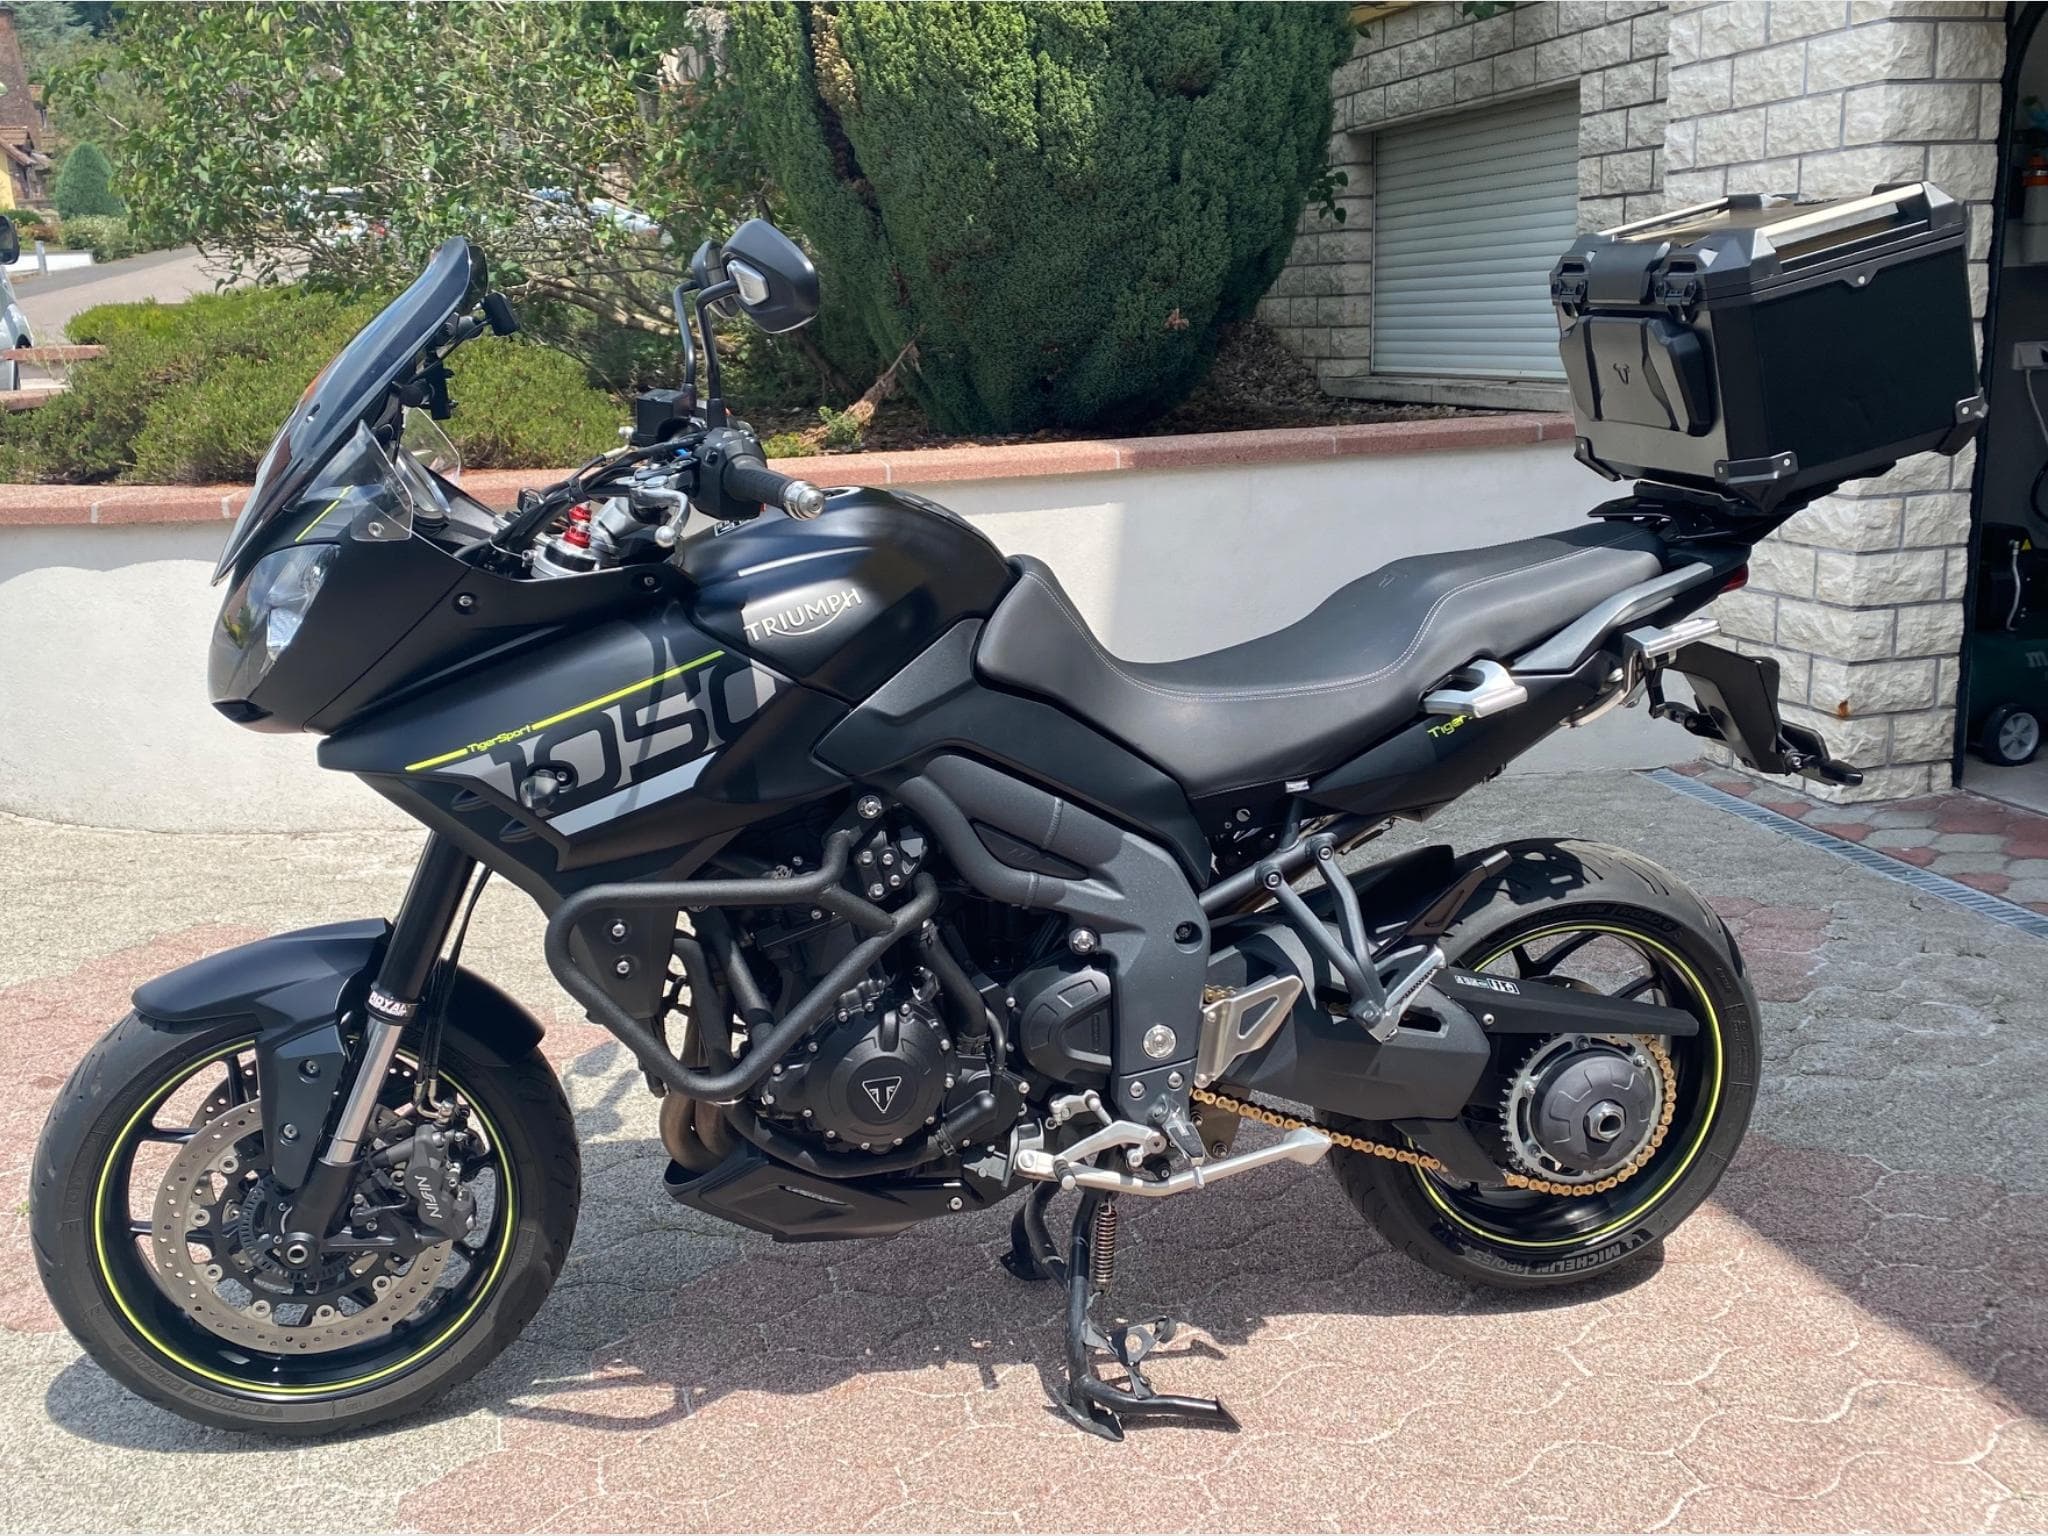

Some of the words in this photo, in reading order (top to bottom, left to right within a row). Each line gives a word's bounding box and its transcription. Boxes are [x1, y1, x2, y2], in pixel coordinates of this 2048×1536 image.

[743, 588, 862, 641] TRIUMPH
[467, 724, 531, 752] TigerSport
[1427, 715, 1466, 738] Tiger
[413, 1175, 443, 1219] NISSIN
